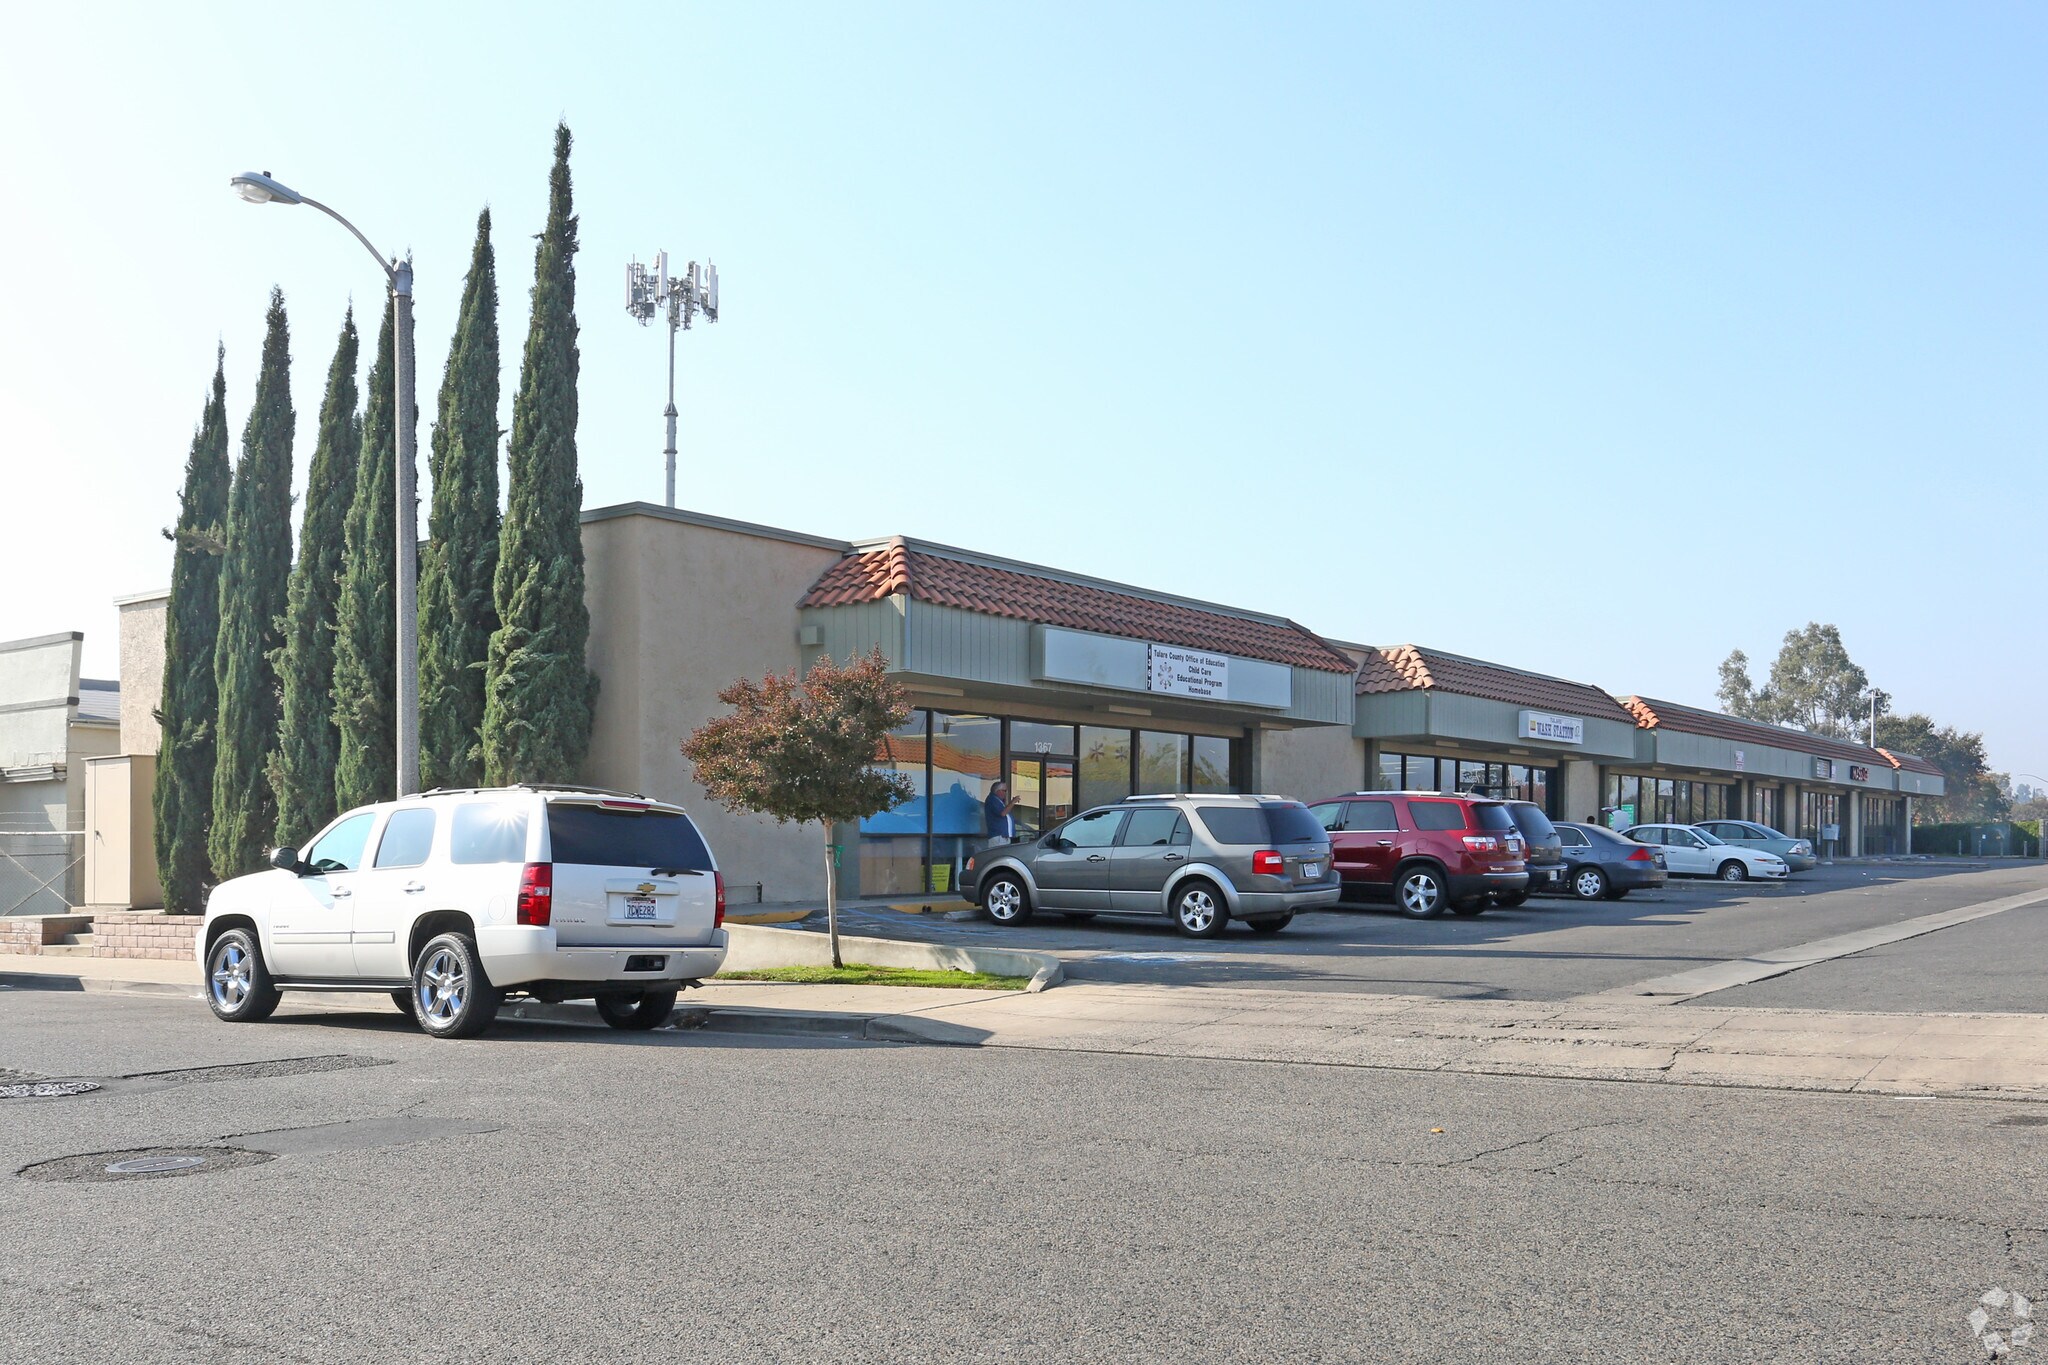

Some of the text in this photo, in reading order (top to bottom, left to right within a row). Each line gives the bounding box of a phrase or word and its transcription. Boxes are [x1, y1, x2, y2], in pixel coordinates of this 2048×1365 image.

[1154, 650, 1168, 658] Tulare
[1169, 652, 1184, 662] County
[1186, 655, 1198, 664] Office
[1206, 658, 1226, 668] Education
[1188, 666, 1212, 676] Child Care
[1177, 674, 1222, 687] Educational Program
[1188, 686, 1212, 695] Homebase
[1537, 722, 1552, 736] WASH
[1553, 725, 1574, 739] STATION
[1034, 742, 1052, 753] 1367
